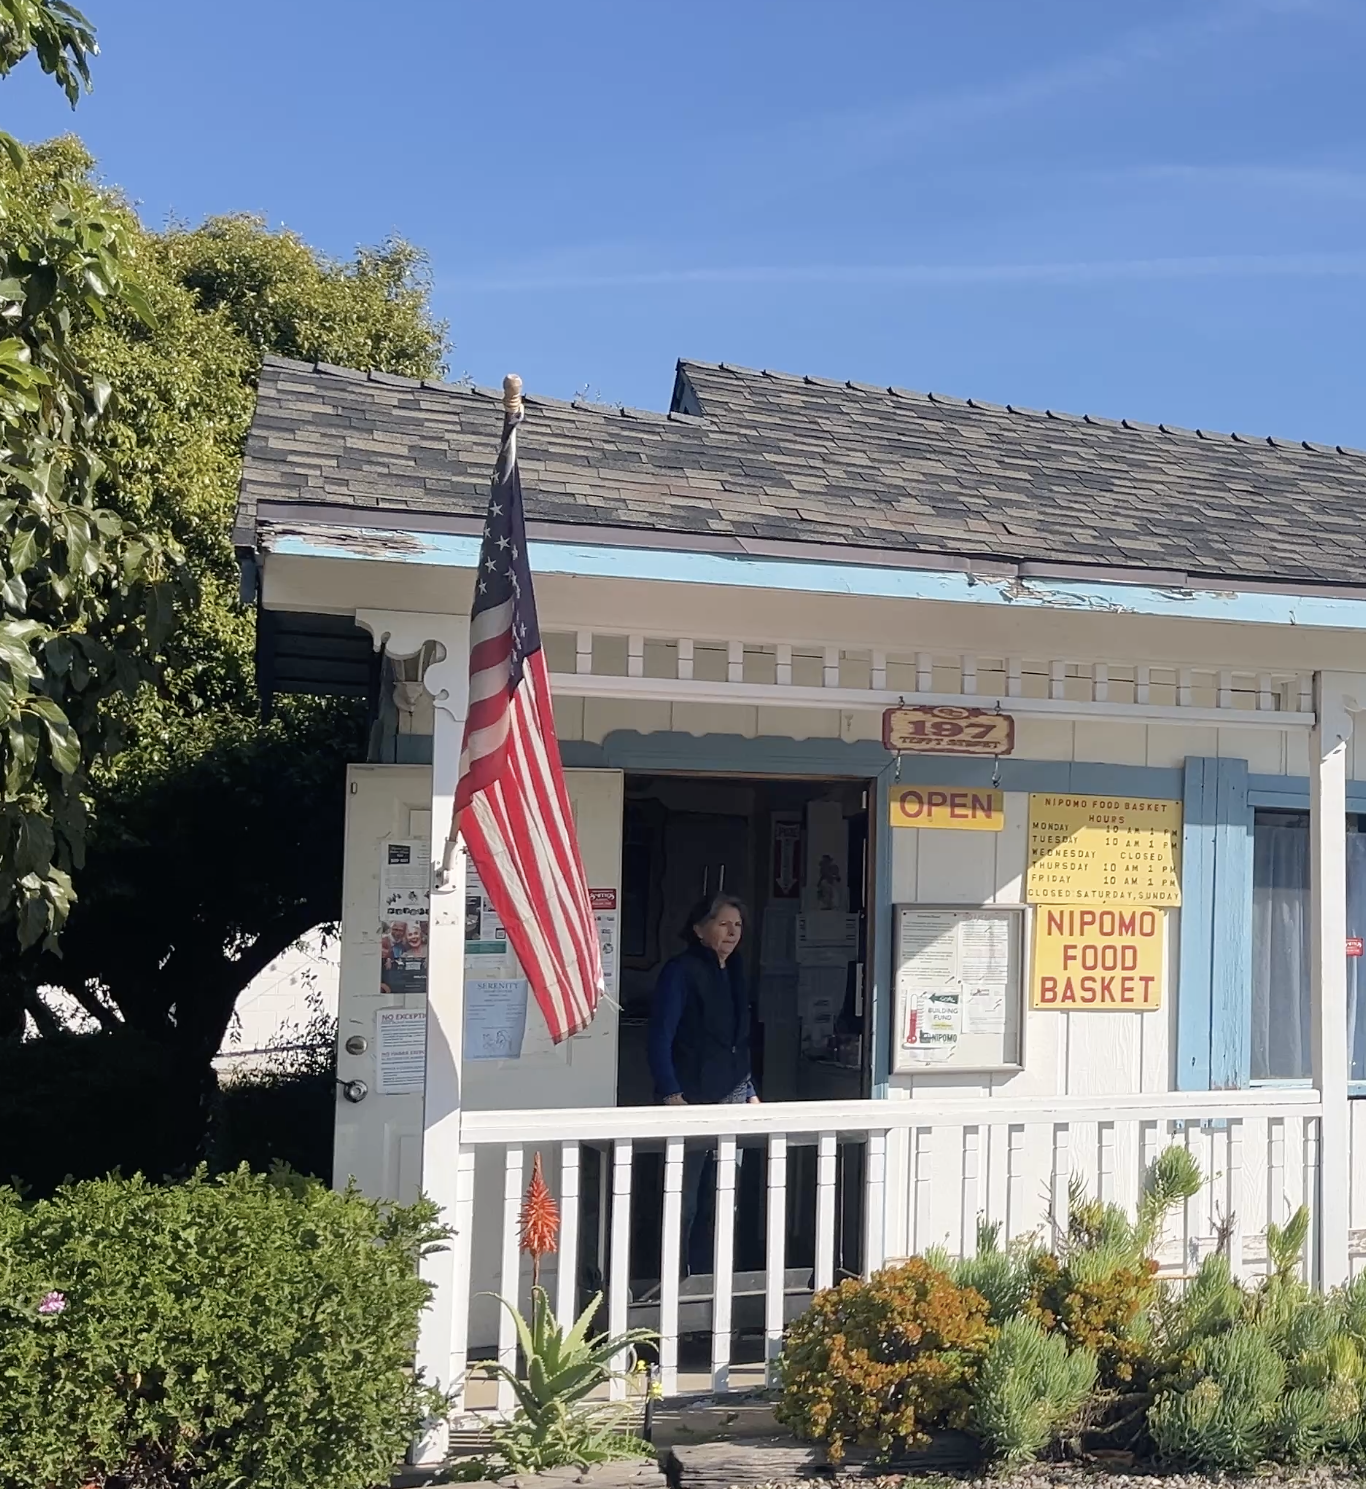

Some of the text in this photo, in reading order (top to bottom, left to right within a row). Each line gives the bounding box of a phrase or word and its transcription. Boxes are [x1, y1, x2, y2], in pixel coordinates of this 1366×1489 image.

[908, 720, 997, 739] 197
[899, 790, 993, 819] OPEN
[1045, 798, 1167, 812] NIPOMO FOOD BASKET
[1088, 814, 1125, 824] HOURS
[1032, 822, 1069, 831] MONDAY
[1106, 825, 1119, 833] 10
[1032, 835, 1078, 844] TUESDAY
[1105, 837, 1118, 846] 10
[1120, 851, 1163, 861] CLOSED
[1032, 861, 1088, 871] THURSDAY
[1103, 863, 1116, 872] 10
[1031, 874, 1071, 883] FRIDAY
[1103, 876, 1116, 884] 10
[1124, 877, 1138, 885] AM
[1028, 888, 1071, 898] CLOSED
[1047, 910, 1156, 937] NIPOMO
[1063, 944, 1138, 971] FOOD
[1040, 976, 1155, 1003] BASKET
[396, 1012, 426, 1020] EXCEPTI
